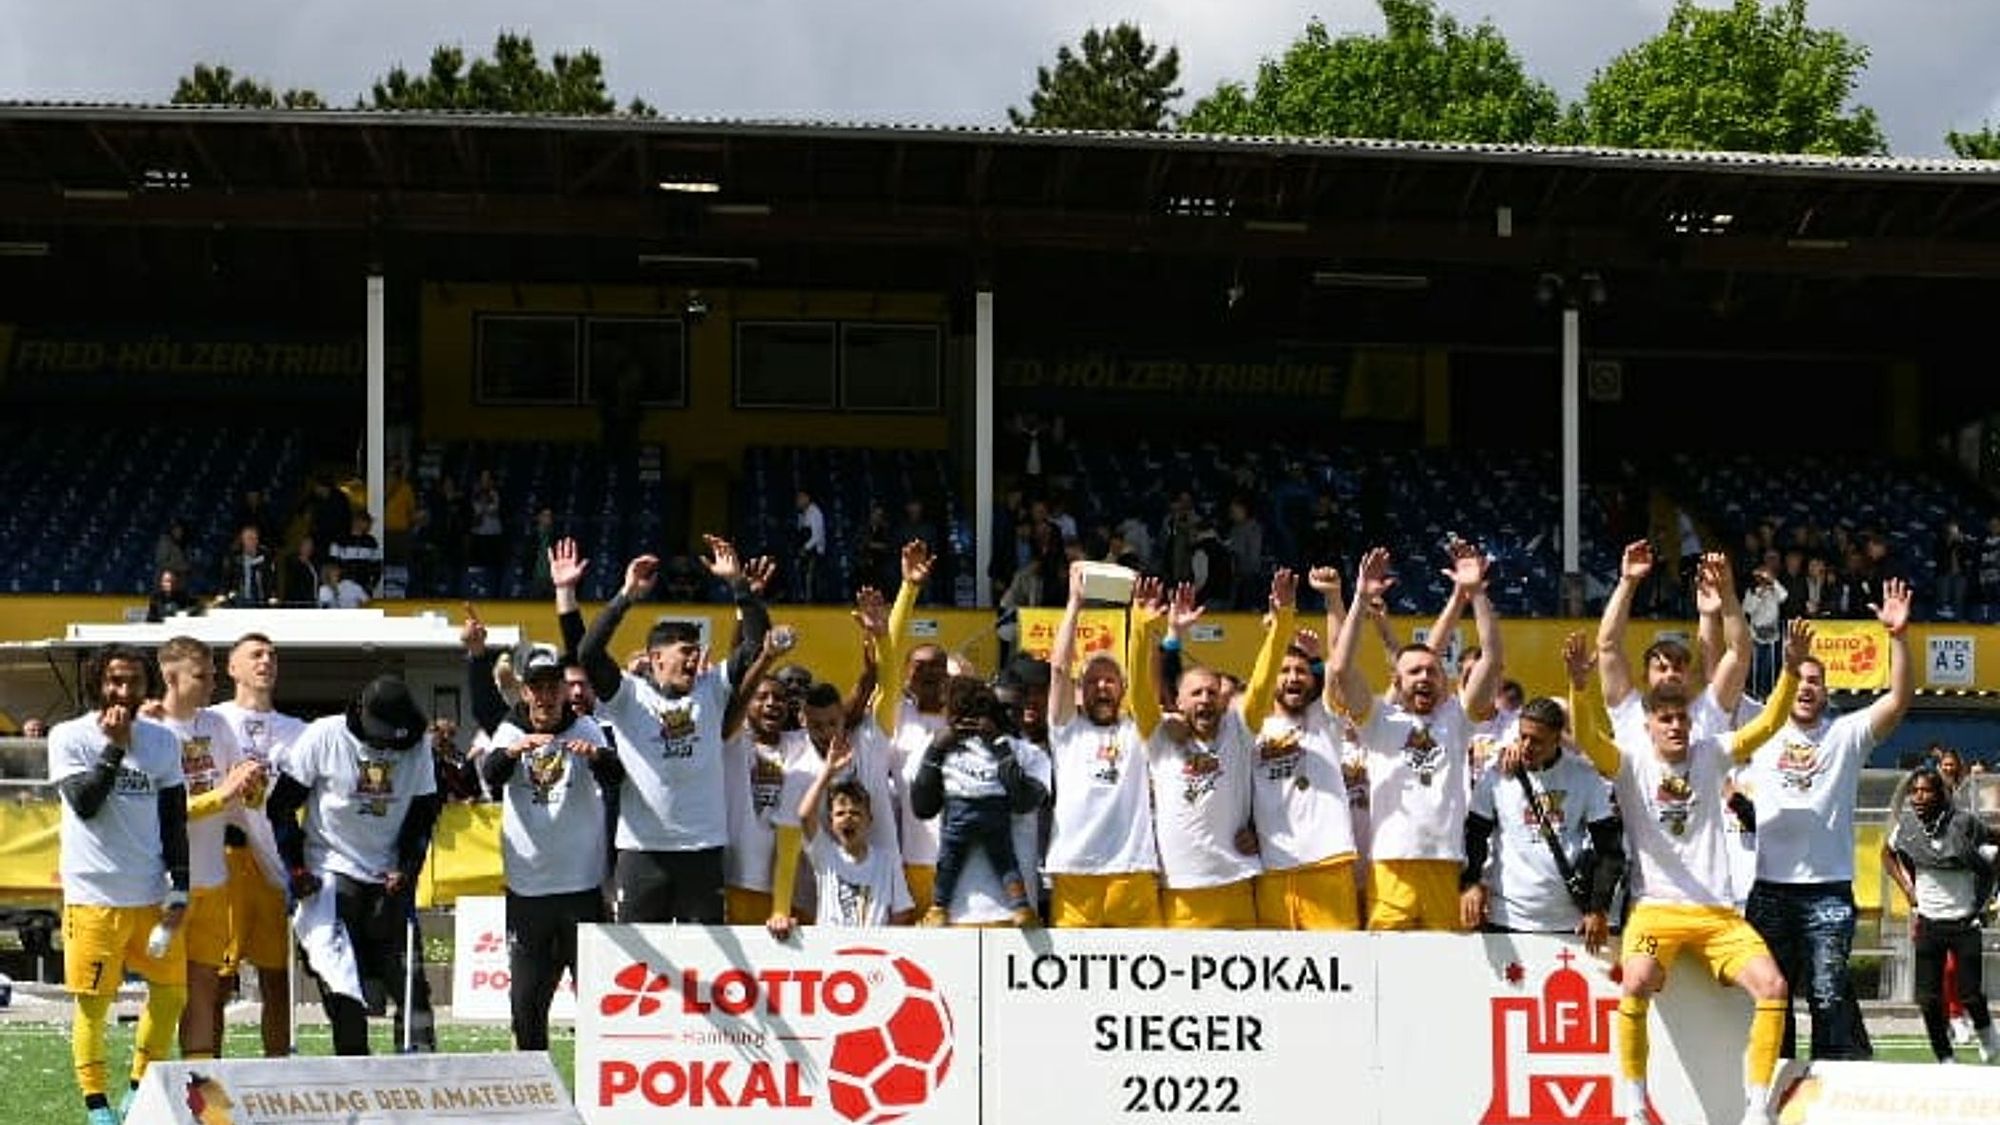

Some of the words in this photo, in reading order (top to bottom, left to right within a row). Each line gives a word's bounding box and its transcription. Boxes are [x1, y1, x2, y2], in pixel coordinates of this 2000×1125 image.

[1000, 354, 1341, 395] ED-HÖLZER-TRIBÜNE
[1935, 652, 1948, 670] A
[1954, 653, 1965, 671] 5
[90, 961, 103, 991] 7
[1007, 953, 1353, 993] LOTTO-POKAL
[682, 969, 869, 1017] LOTTO
[1095, 1015, 1263, 1052] SIEGER
[241, 1089, 371, 1117] FINALTAG
[372, 1088, 425, 1111] DER
[430, 1081, 560, 1109] AMATEURE
[599, 1060, 813, 1108] POKAL
[1123, 1076, 1241, 1113] 2022
